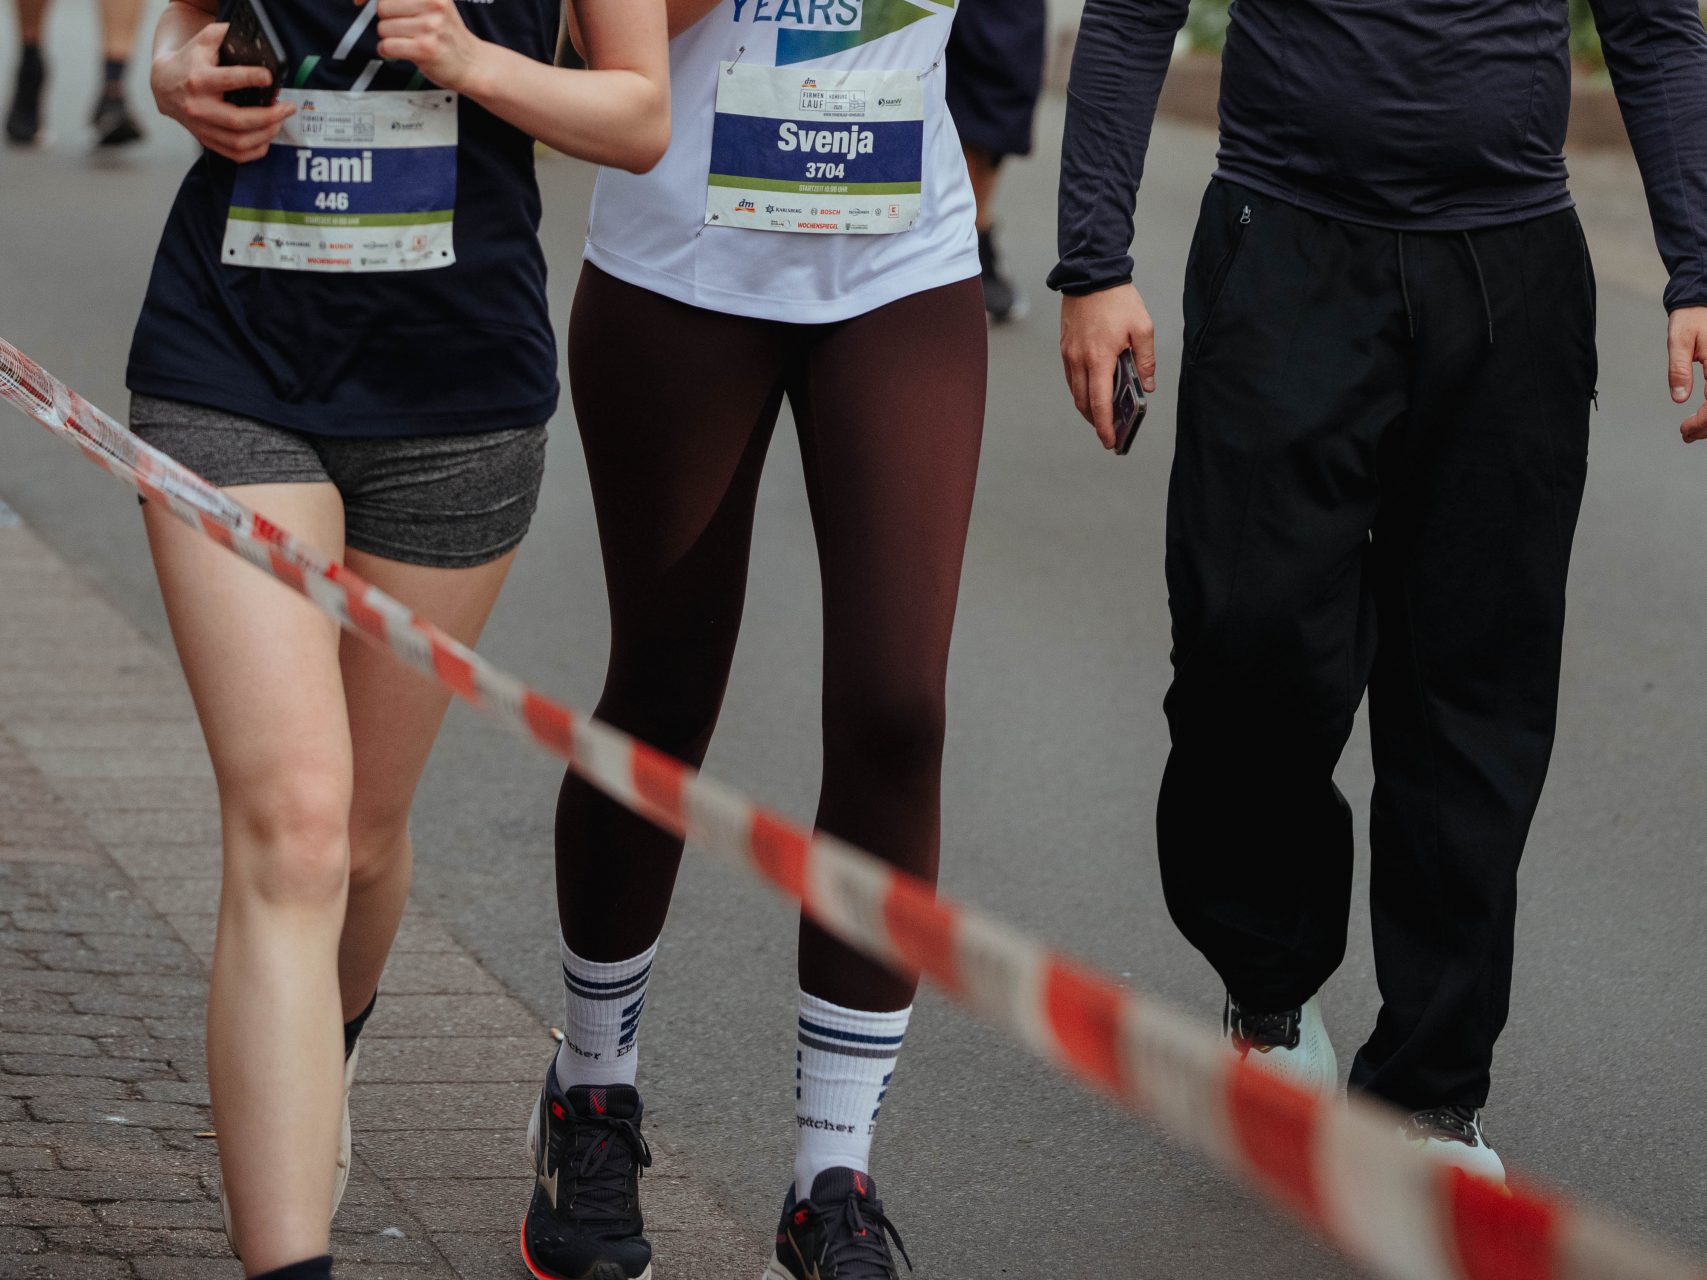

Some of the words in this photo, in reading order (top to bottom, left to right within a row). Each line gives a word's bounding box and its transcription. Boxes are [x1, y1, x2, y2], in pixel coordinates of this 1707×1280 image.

[804, 77, 816, 86] dm
[802, 91, 824, 99] FIRMEN
[802, 99, 824, 109] LAUF
[777, 122, 874, 160] Svenja
[296, 149, 373, 182] Tami
[805, 162, 845, 179] 3704
[315, 192, 349, 210] 446
[738, 198, 755, 208] dm
[797, 222, 838, 230] WOCHENSPIEGEL
[797, 1114, 855, 1133] pächer
